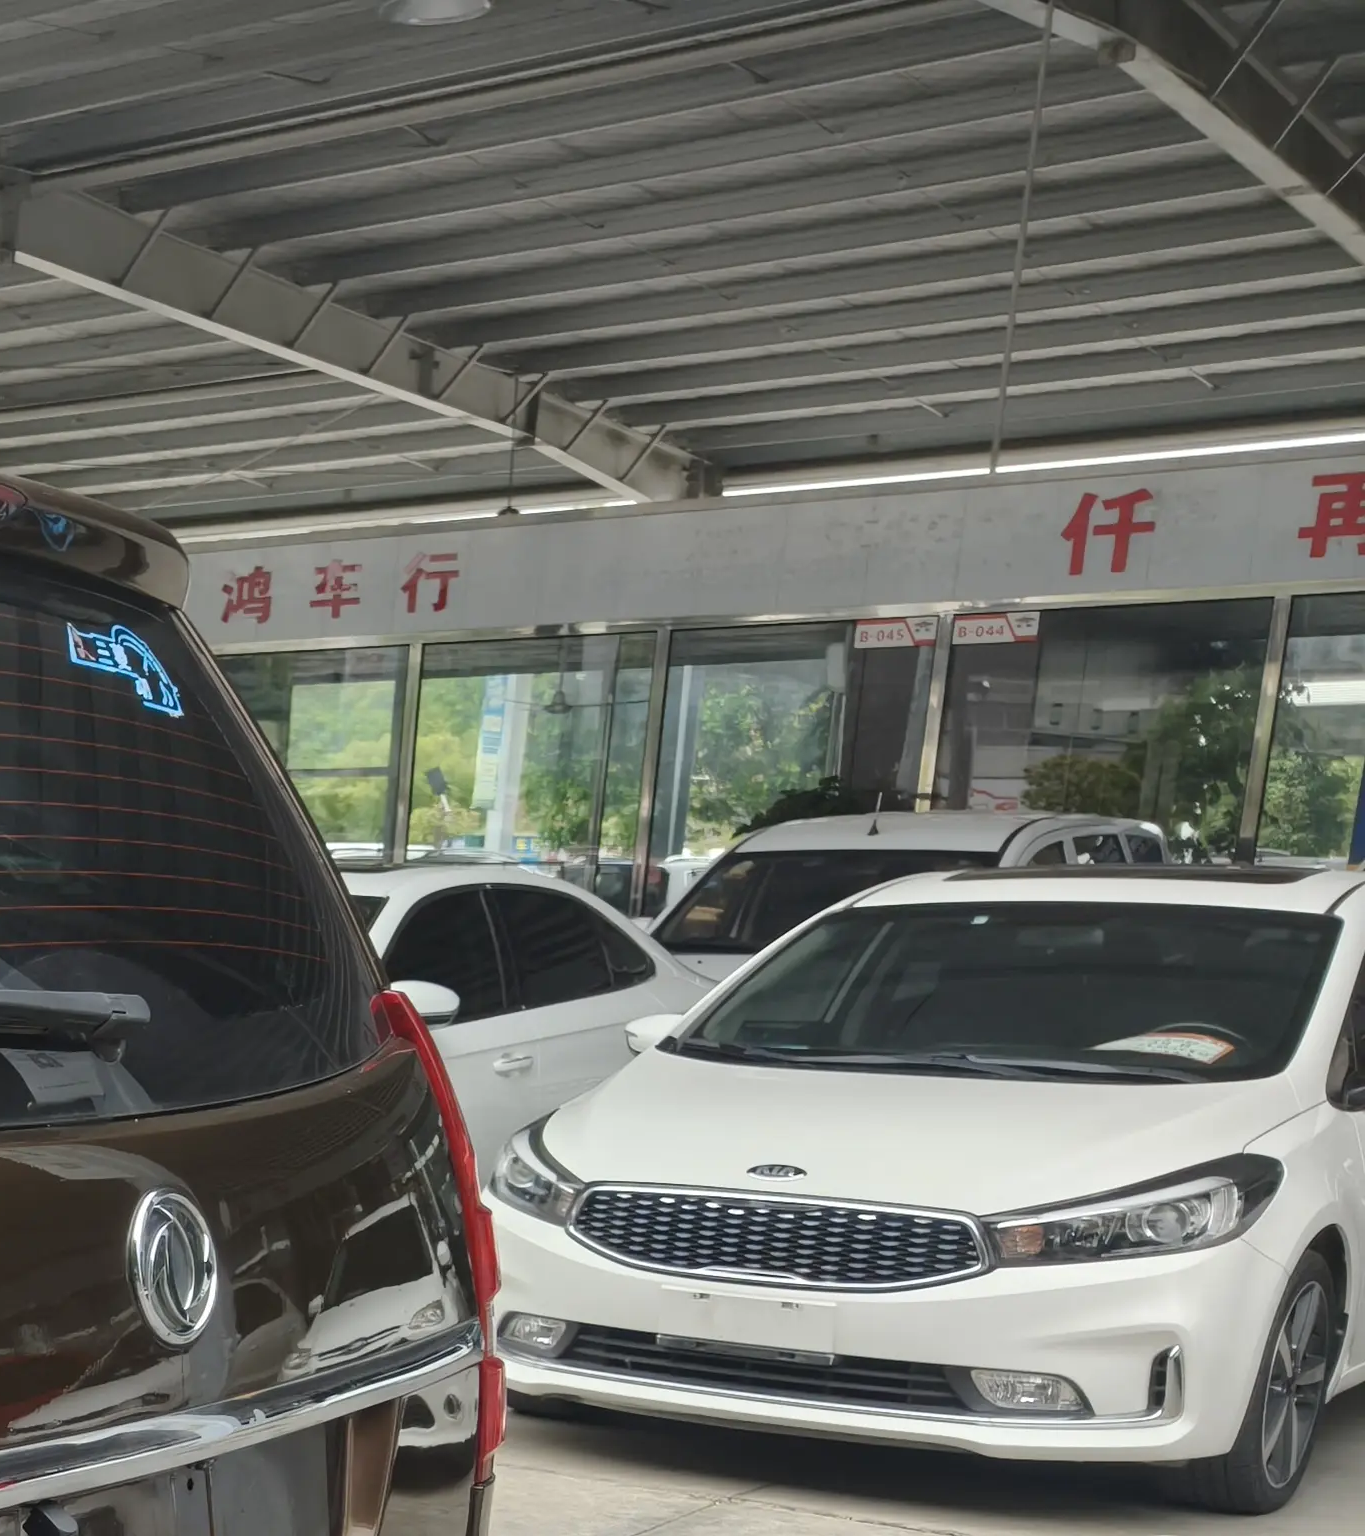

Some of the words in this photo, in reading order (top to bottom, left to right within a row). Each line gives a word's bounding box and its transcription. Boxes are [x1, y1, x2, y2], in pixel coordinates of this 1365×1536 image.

[221, 552, 461, 624] 鸿车行
[859, 628, 905, 643] B-045
[957, 625, 1005, 638] B-044
